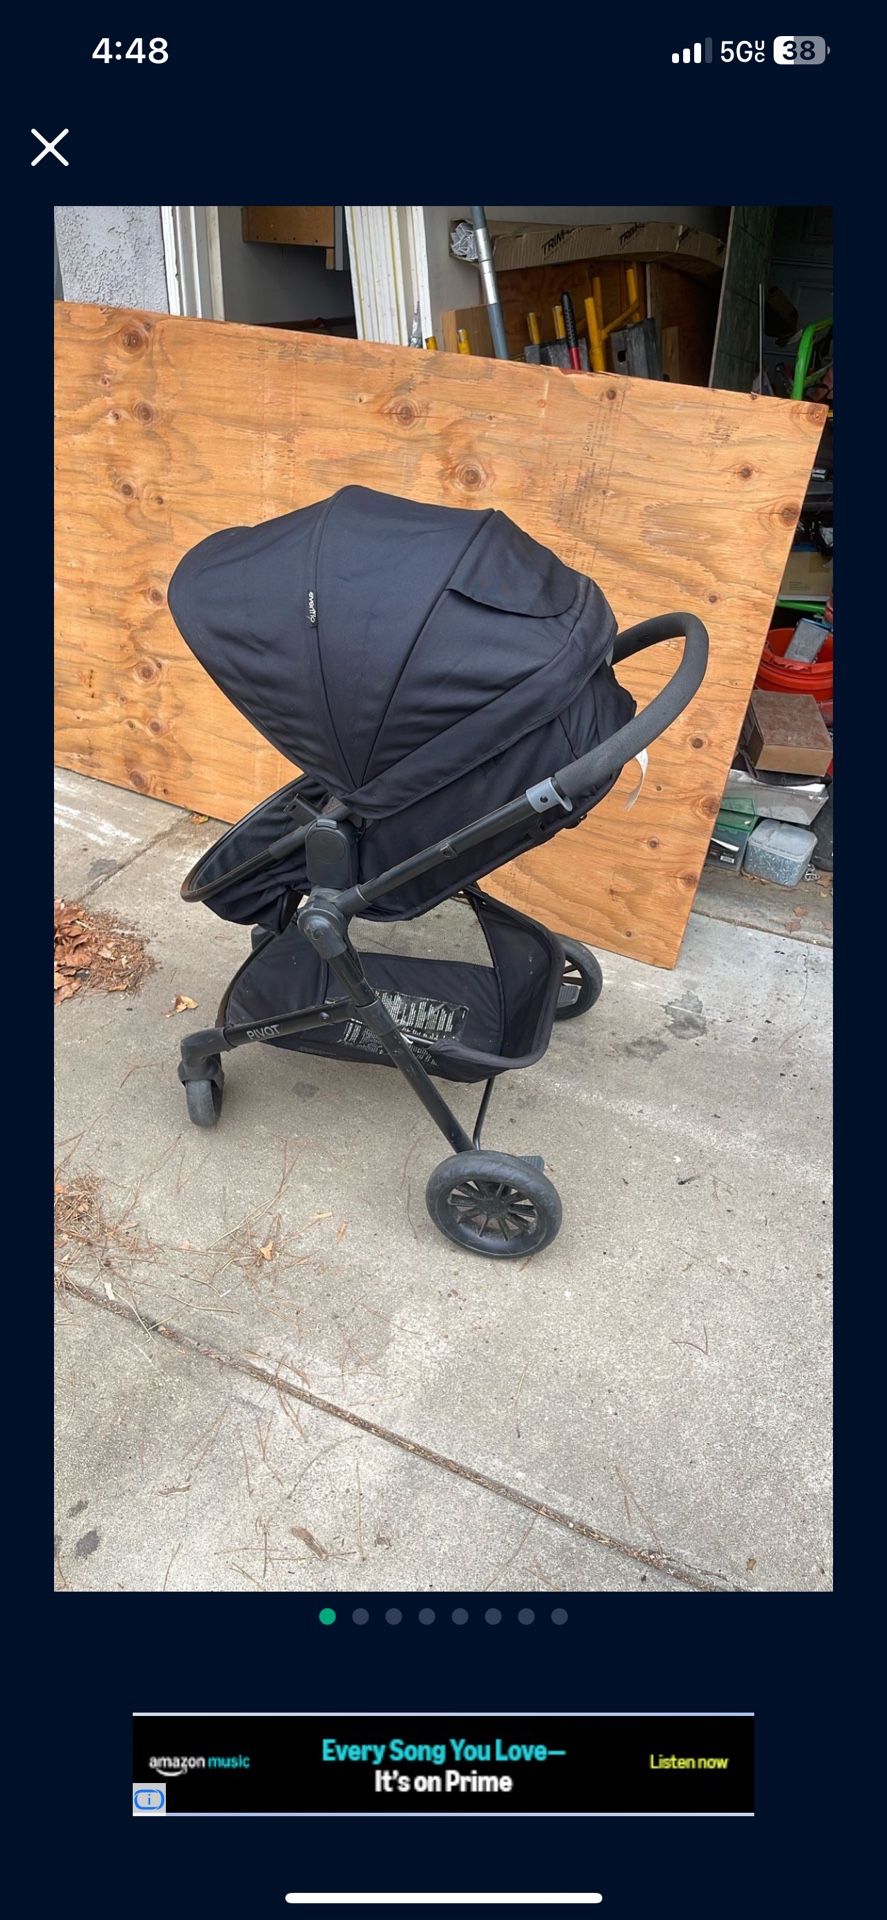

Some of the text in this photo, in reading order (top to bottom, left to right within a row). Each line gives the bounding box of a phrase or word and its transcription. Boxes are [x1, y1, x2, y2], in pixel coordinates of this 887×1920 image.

[92, 37, 169, 64] 4:48
[782, 40, 816, 61] 38
[246, 1024, 280, 1040] PIVOT
[322, 1738, 385, 1765] Every
[389, 1738, 446, 1765] Song
[449, 1738, 491, 1761] You
[650, 1754, 729, 1769] Listen now
[149, 1754, 250, 1771] amazon music
[414, 1774, 442, 1792] on
[445, 1770, 513, 1792] Prime
